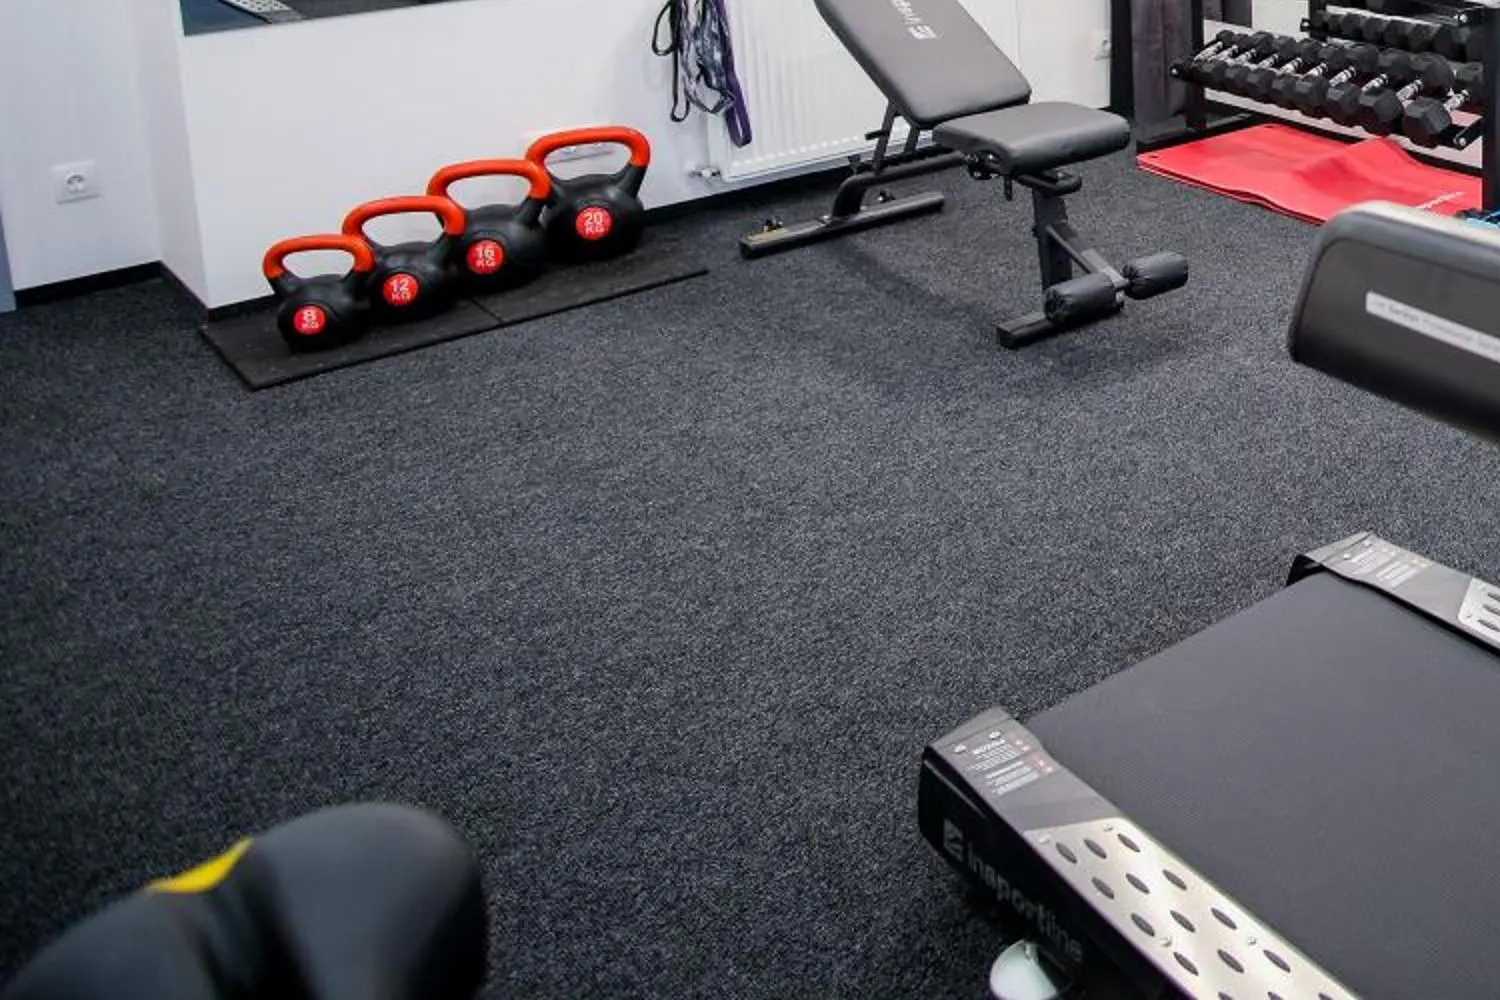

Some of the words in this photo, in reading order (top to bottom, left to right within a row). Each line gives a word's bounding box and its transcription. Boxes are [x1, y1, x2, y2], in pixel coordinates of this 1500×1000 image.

[584, 210, 604, 223] 20
[584, 222, 605, 233] KG
[475, 246, 495, 259] 16
[475, 258, 496, 268] KG
[391, 279, 410, 292] 12
[391, 291, 411, 301] KG
[303, 308, 317, 320] 8
[301, 319, 320, 329] KG
